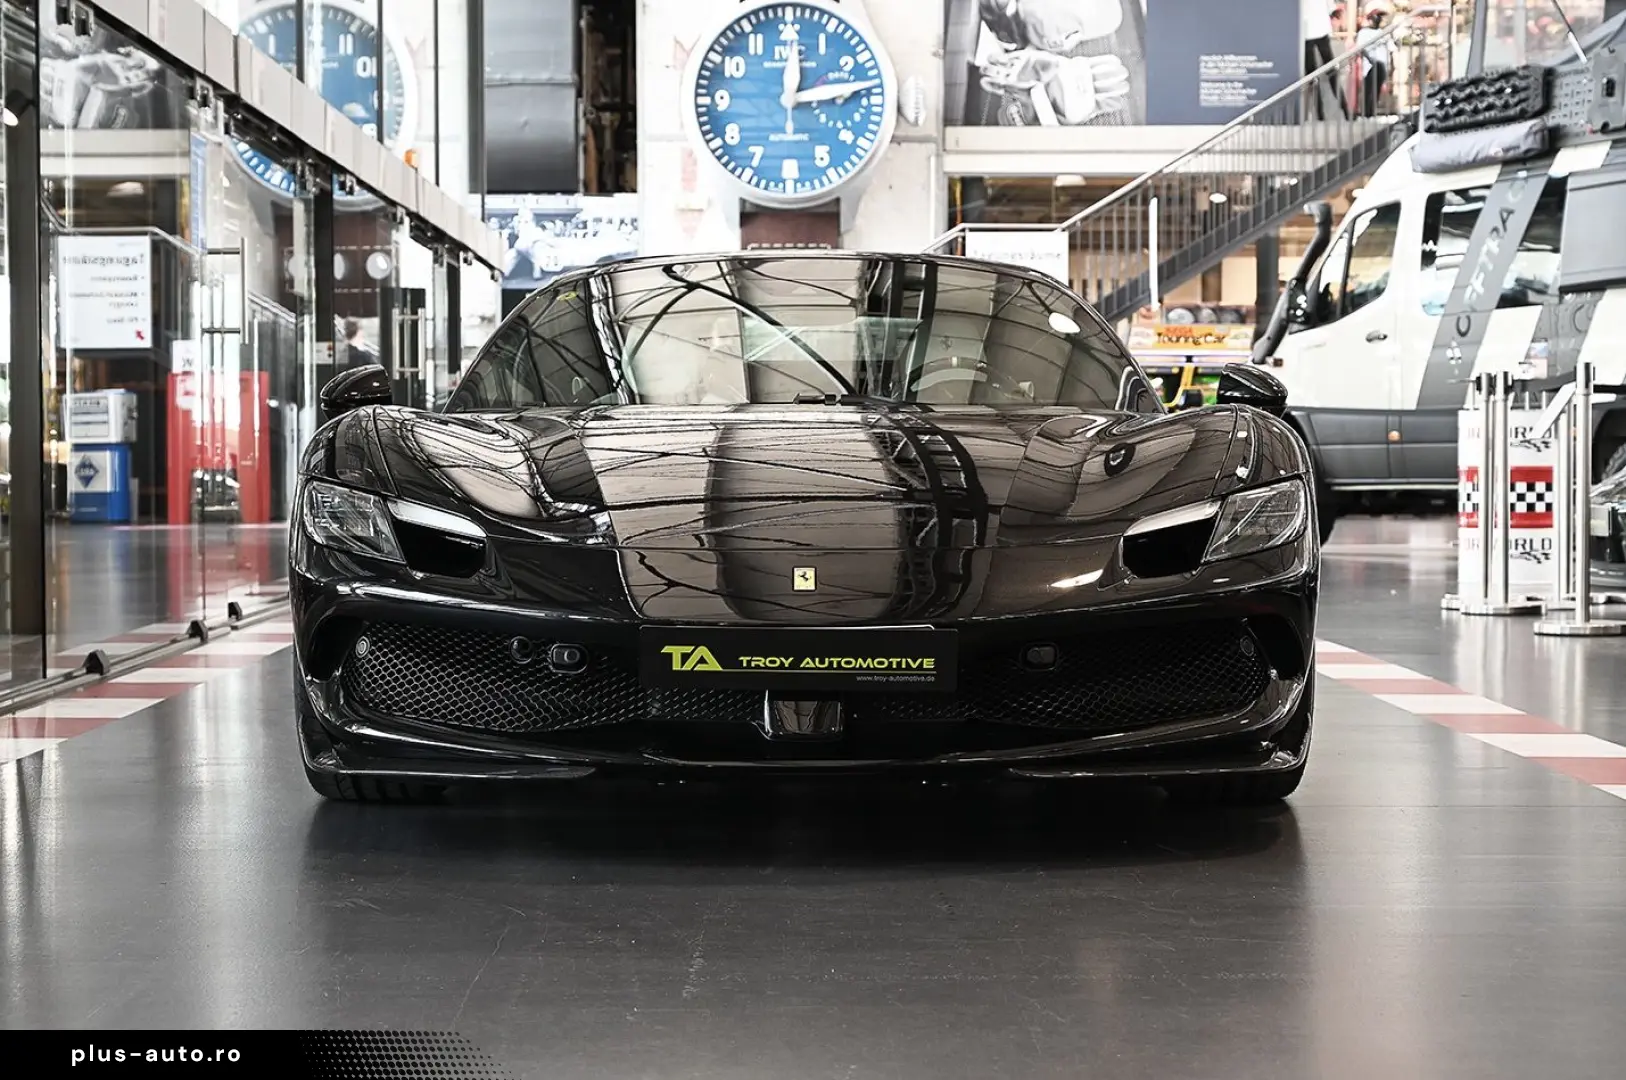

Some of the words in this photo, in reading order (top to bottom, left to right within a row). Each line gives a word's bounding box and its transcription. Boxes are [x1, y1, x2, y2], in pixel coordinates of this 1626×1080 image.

[724, 56, 745, 78] 10
[714, 89, 730, 111] 9
[725, 123, 740, 146] 8
[748, 145, 764, 168] 7
[814, 145, 830, 168] 5
[661, 645, 723, 671] TA
[739, 656, 794, 669] TROY
[799, 656, 936, 669] AUTOMOTIVE
[856, 675, 936, 683] www.troy-automotive.de
